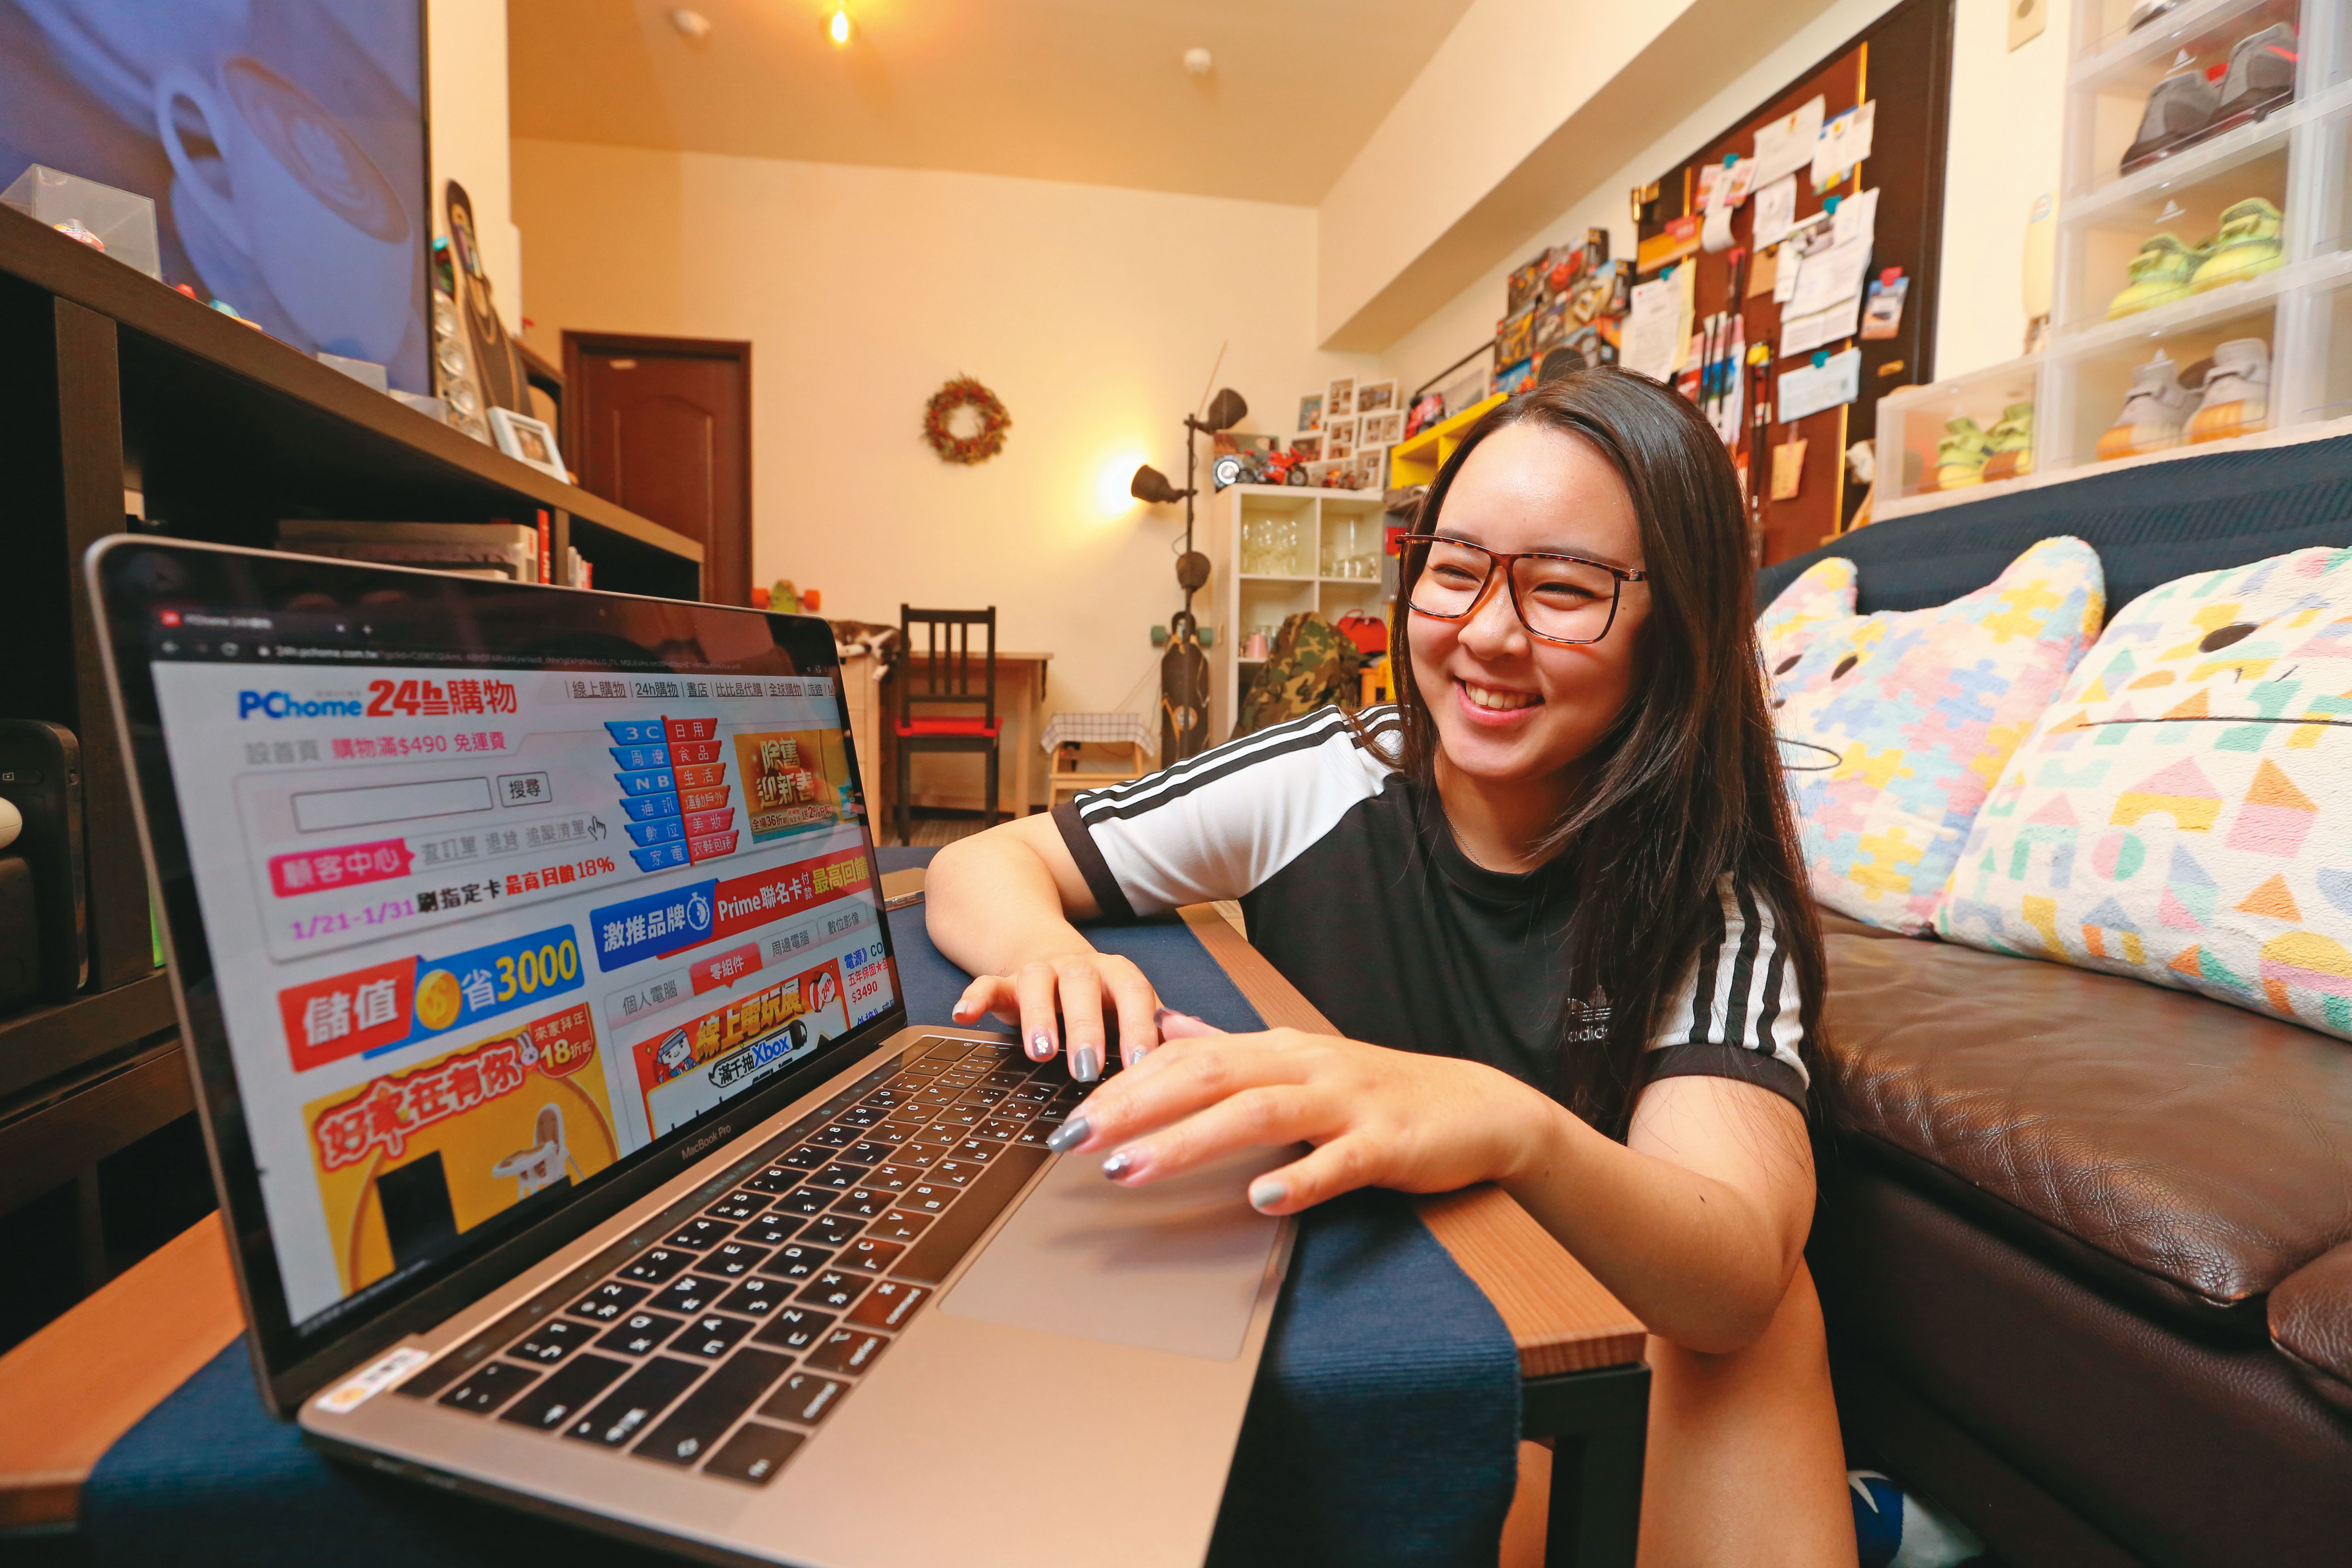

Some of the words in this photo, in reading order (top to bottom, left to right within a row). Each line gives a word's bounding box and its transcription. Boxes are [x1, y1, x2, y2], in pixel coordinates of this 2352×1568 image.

[572, 680, 626, 697] 線上購物
[635, 681, 678, 697] 24h購物
[686, 682, 708, 697] 書店
[715, 682, 762, 696] 比比昂代購
[769, 683, 801, 696] 全球購物
[807, 683, 823, 696] 旅遊
[238, 690, 363, 720] PChome
[454, 731, 506, 753] 免運費
[675, 722, 704, 738] 日用
[678, 745, 709, 762] 食品
[760, 736, 800, 775] 除舊
[509, 778, 541, 799] 搜尋
[684, 768, 714, 786] 生活
[755, 768, 815, 811] 迎新春
[641, 796, 674, 817] 通訊
[282, 847, 401, 888] 顧客中心
[650, 845, 684, 867] 家電
[603, 903, 686, 953] 激推品牌
[622, 980, 678, 1016] 個人電腦
[710, 955, 744, 980] 零組件
[771, 930, 810, 957] 周邊電腦
[827, 911, 860, 935] 數位影像
[851, 980, 878, 1004] $3490
[302, 979, 399, 1047] 儲值
[695, 978, 804, 1062] 線上電玩展
[681, 1132, 718, 1160] MacBook
[718, 1125, 731, 1137] Pro
